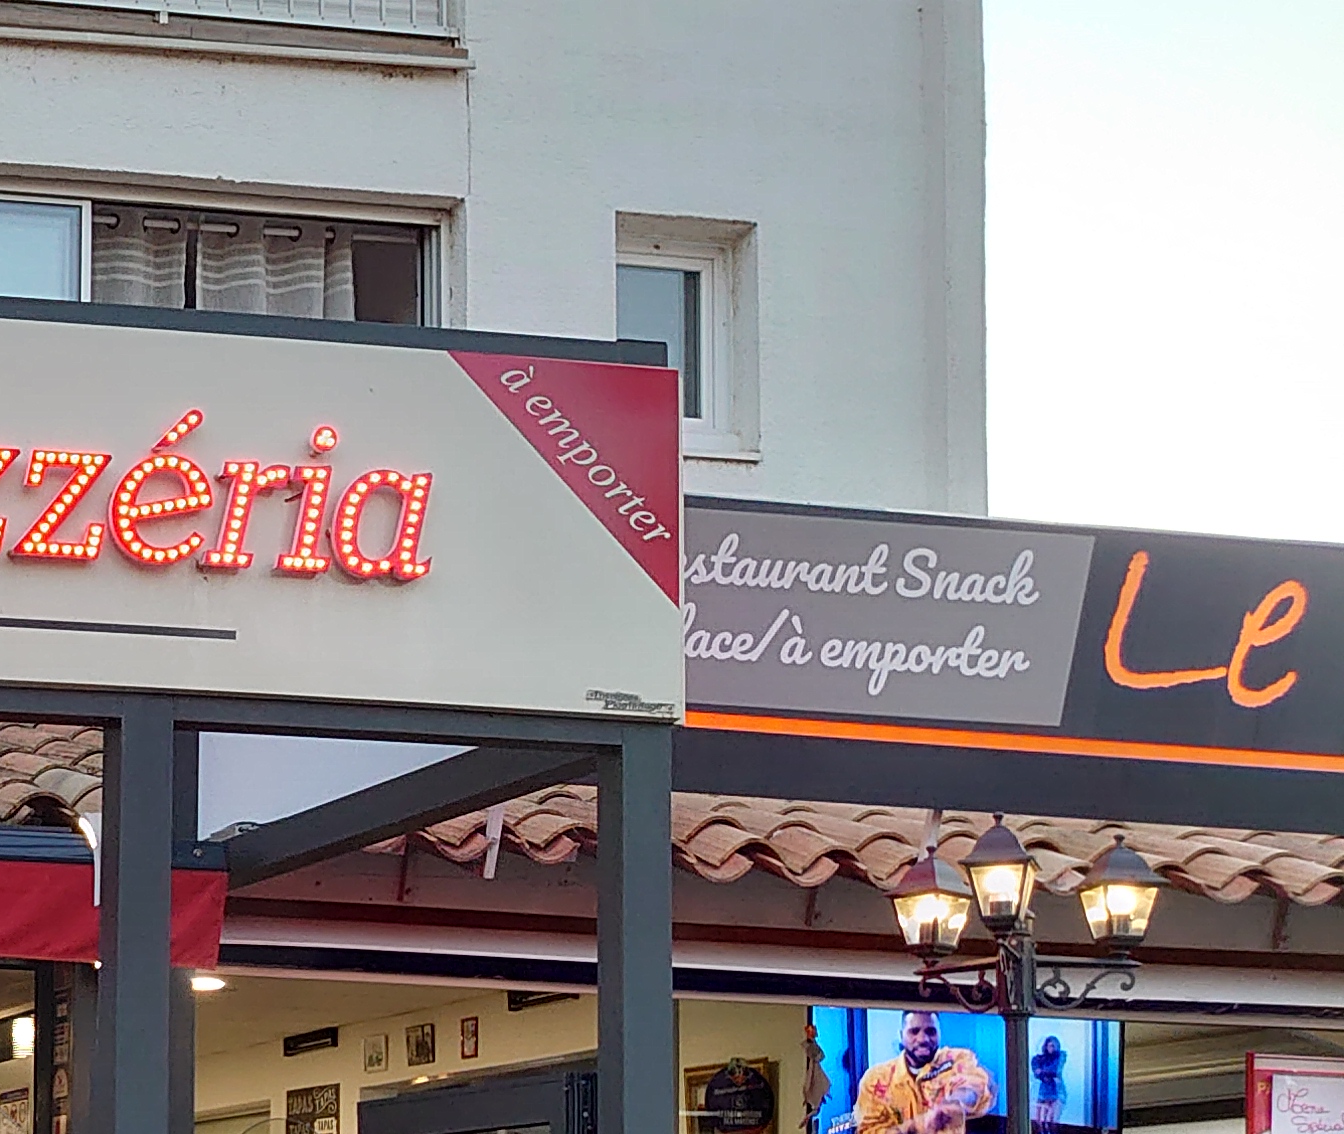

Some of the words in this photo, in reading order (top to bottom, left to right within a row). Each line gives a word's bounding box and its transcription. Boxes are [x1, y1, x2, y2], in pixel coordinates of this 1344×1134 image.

[500, 365, 534, 393] à
[525, 395, 671, 541] emporter
[684, 533, 888, 593] staurant
[895, 546, 1039, 606] Snack
[820, 625, 1030, 695] emporter
[1104, 550, 1308, 708] Le
